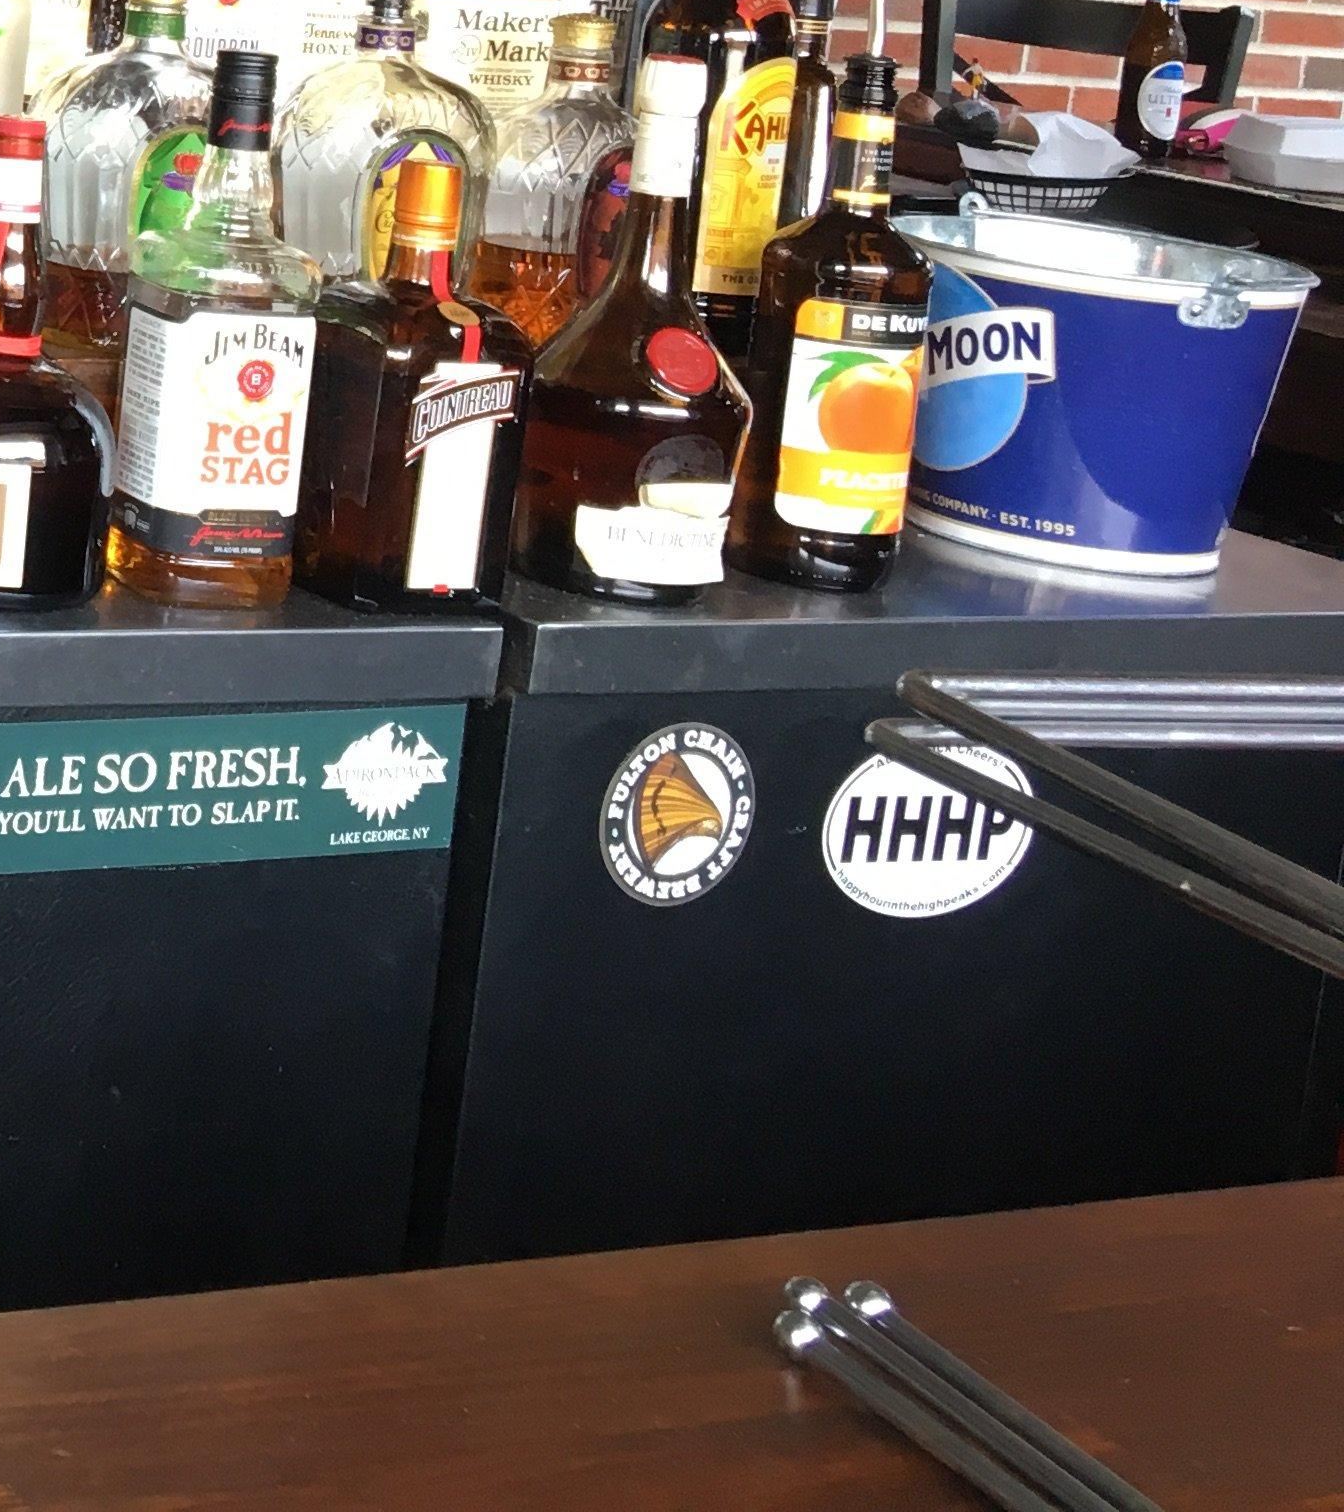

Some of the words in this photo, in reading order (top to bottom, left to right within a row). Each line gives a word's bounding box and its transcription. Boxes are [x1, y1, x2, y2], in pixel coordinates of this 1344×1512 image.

[302, 42, 354, 56] HONE
[483, 39, 552, 64] Mark
[468, 73, 535, 88] WHISKY
[721, 100, 792, 157] KAHL
[203, 330, 247, 366] JIM
[252, 322, 306, 369] BEAM
[851, 314, 887, 332] DE
[926, 321, 1042, 377] MOON
[203, 410, 293, 456] red
[412, 380, 514, 444] COINTREAU
[199, 455, 291, 487] STAG
[1034, 518, 1077, 538] 1995
[93, 752, 157, 797] SO
[165, 744, 308, 792] FRESH,
[330, 763, 437, 787] ADIRONDACK
[607, 732, 677, 820] FULTON
[683, 729, 747, 781] CHAIN
[93, 803, 164, 832] WANT
[168, 803, 202, 829] TO
[210, 799, 271, 826] SLAP
[274, 797, 301, 823] IT.
[328, 829, 361, 847] LAKE
[412, 826, 431, 841] NY
[839, 794, 1015, 864] HHHP
[705, 795, 752, 881] CRAFT
[608, 841, 703, 901] BREWERY
